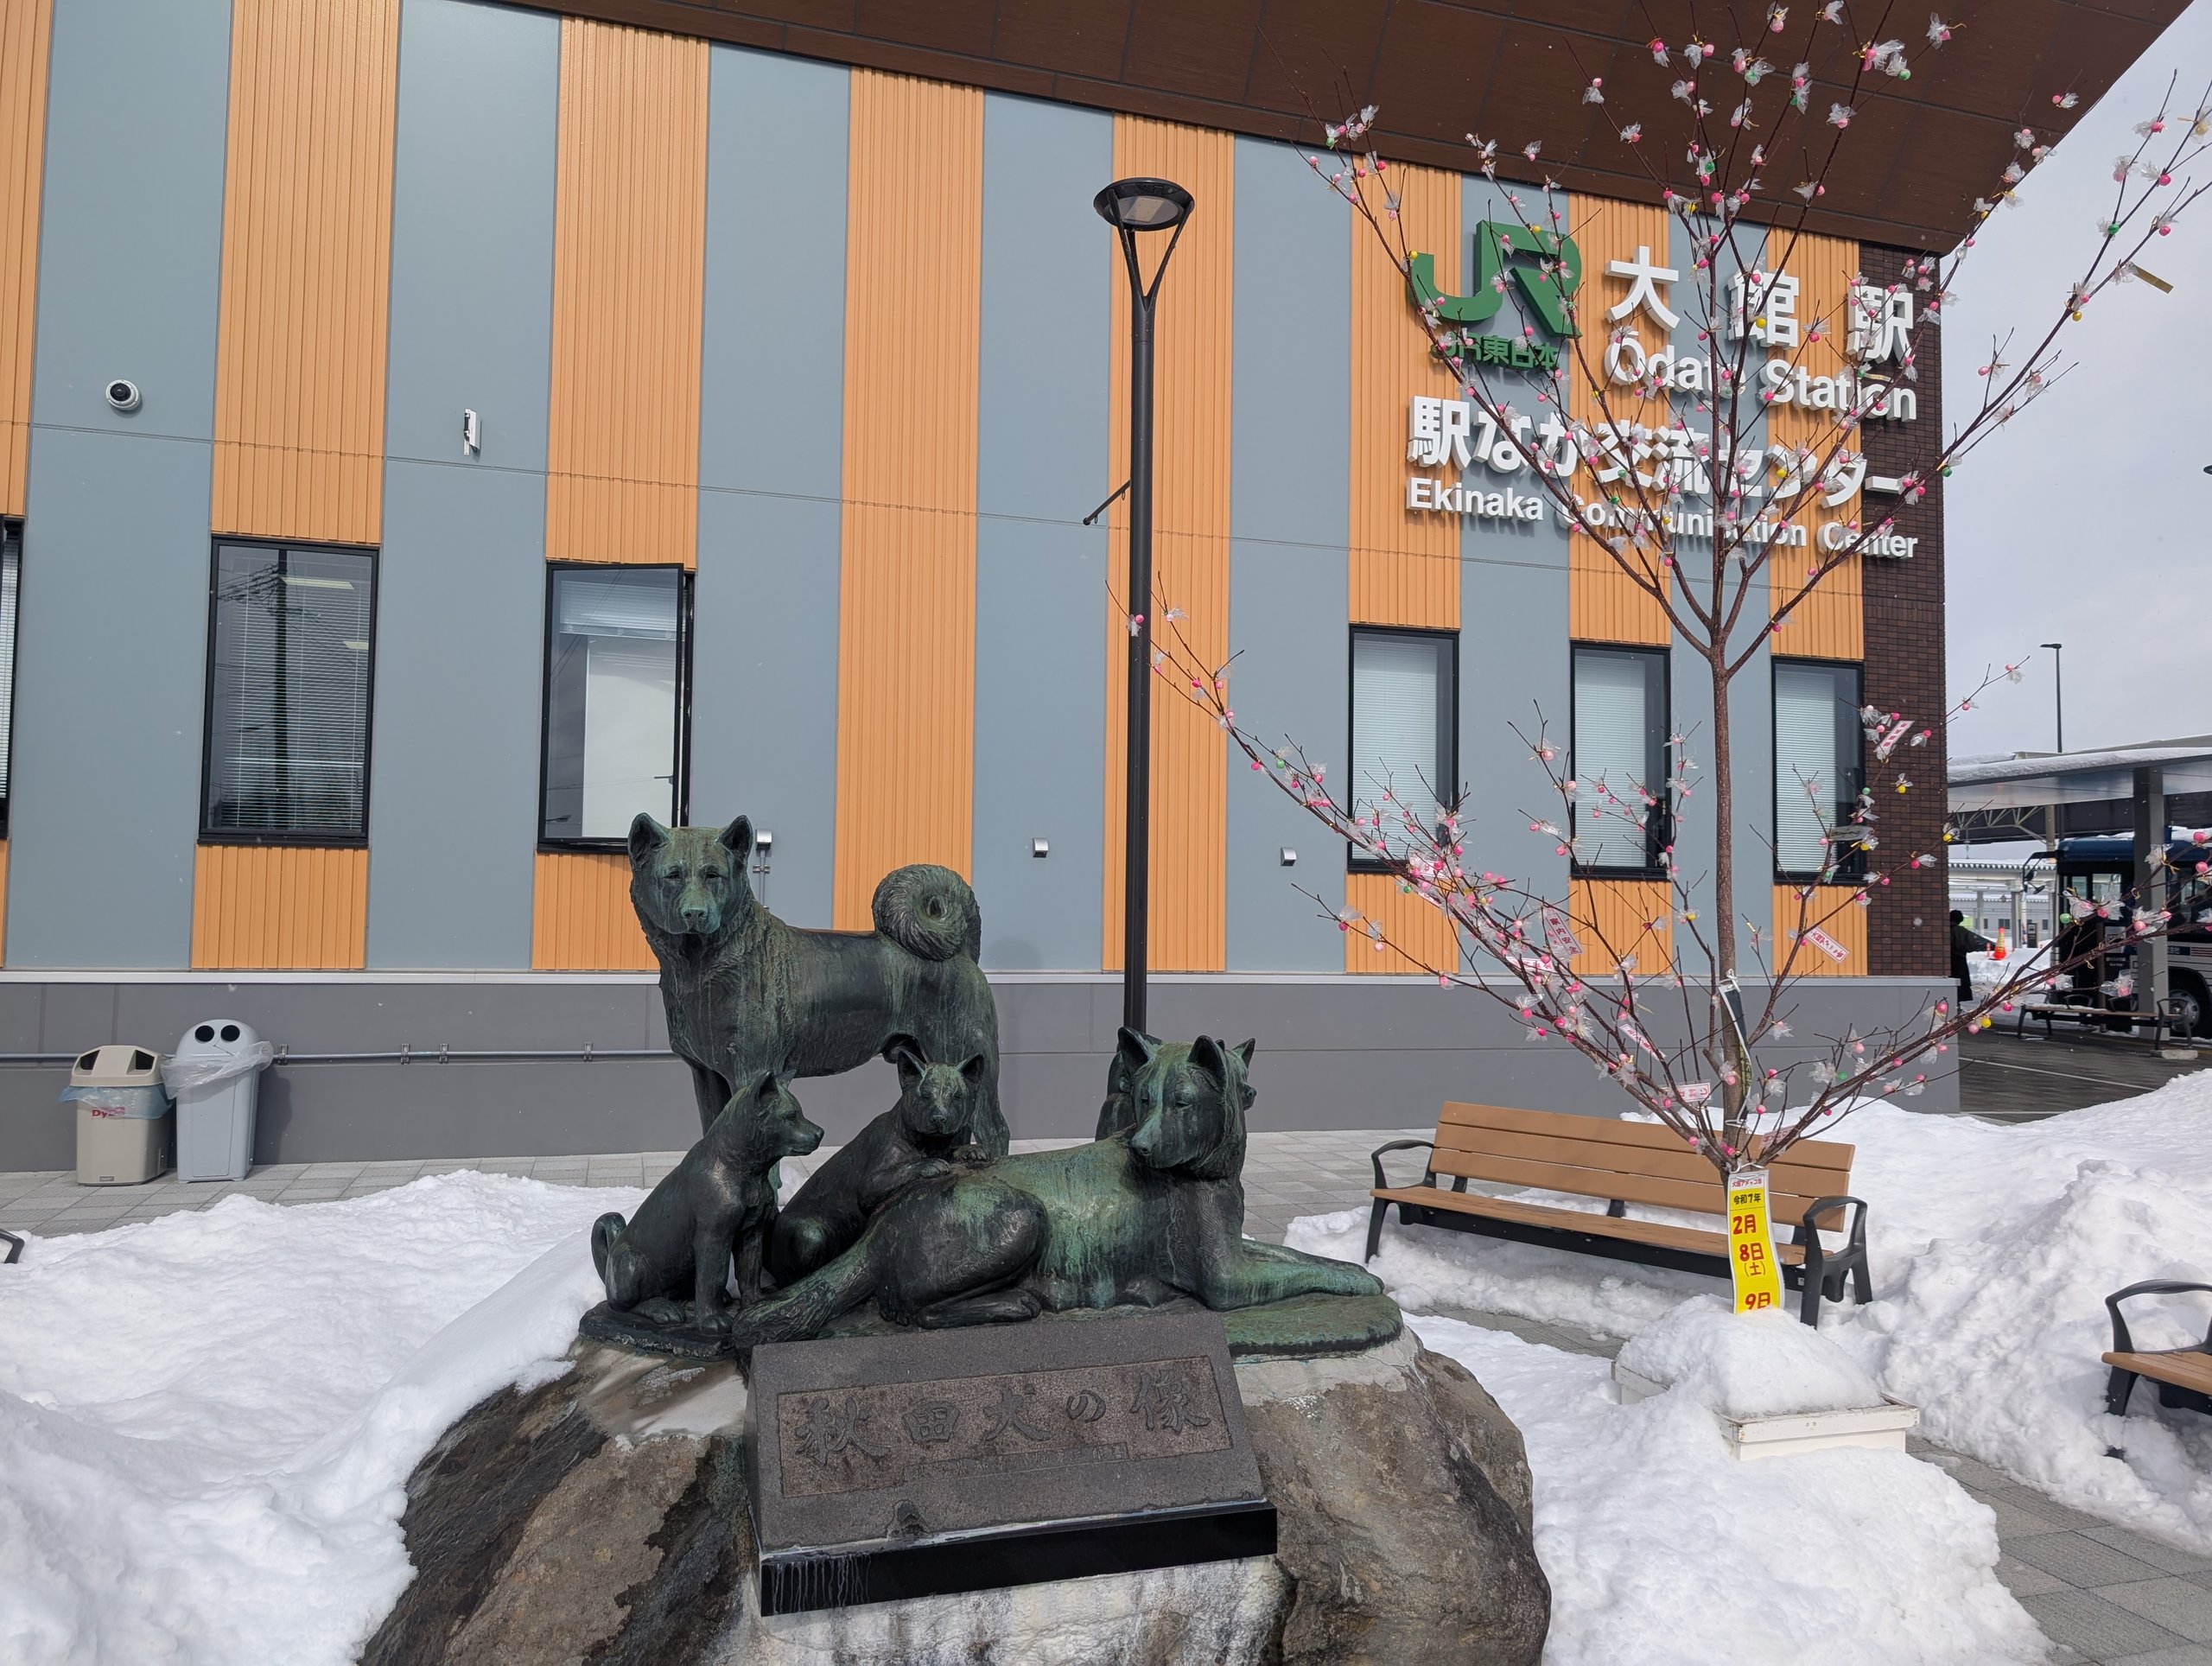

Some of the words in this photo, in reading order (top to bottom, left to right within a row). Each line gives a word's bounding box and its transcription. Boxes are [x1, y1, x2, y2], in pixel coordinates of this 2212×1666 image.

[1408, 219, 1583, 338] JR
[1606, 245, 1914, 361] 大館駅
[1431, 330, 1559, 371] JR東日本
[1764, 359, 1916, 421] Station
[1409, 395, 1910, 509] 駅なか交流センター
[1409, 477, 1544, 521] Ekinaka
[1821, 521, 1918, 558] Center
[1732, 1213, 1757, 1235] 2月
[1733, 1192, 1762, 1205] 令和7年
[1739, 1242, 1764, 1262] 8日
[1745, 1292, 1770, 1311] 9日
[794, 1369, 1211, 1467] 秋田犬の像
